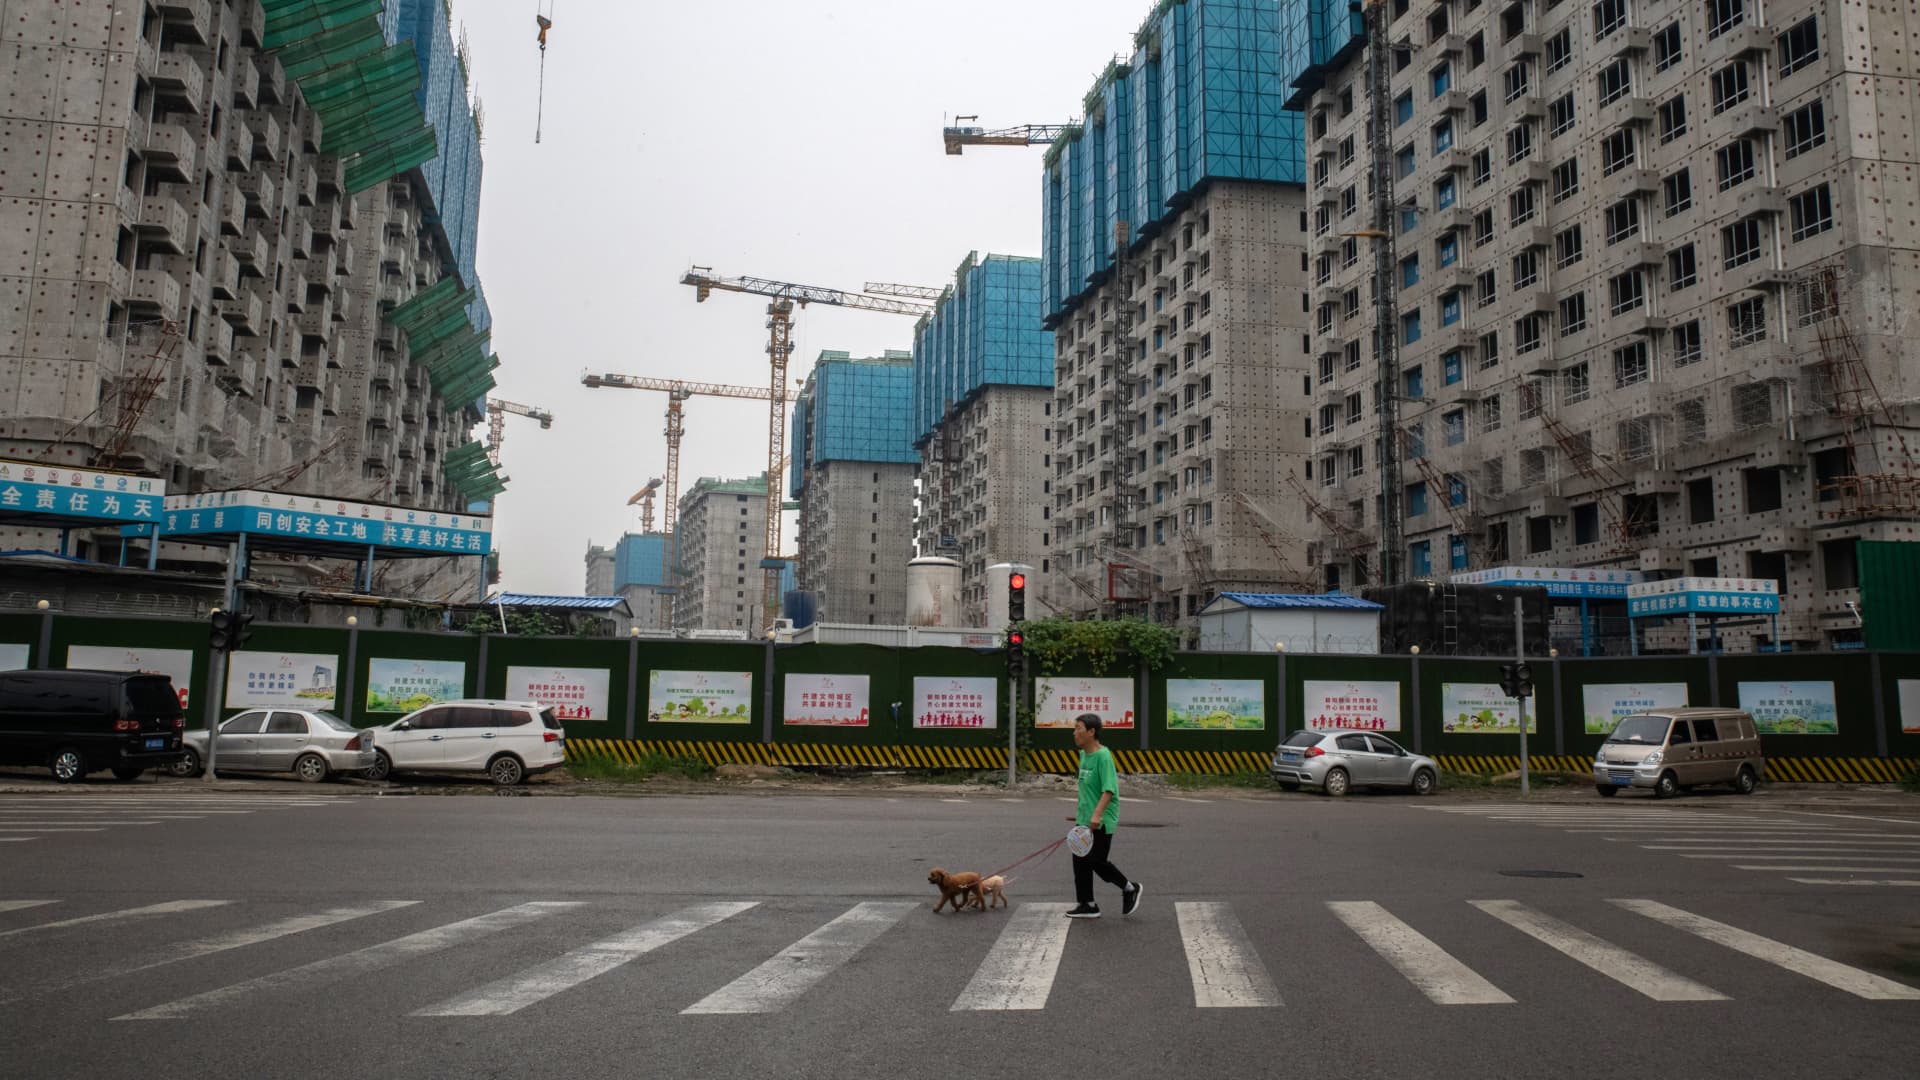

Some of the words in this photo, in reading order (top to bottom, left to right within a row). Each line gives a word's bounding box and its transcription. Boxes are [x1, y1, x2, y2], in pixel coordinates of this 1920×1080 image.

[1, 486, 152, 517] 全责任为天
[257, 511, 367, 539] 同创安全工地
[384, 525, 482, 550] 共享美好生活
[1697, 595, 1773, 609] 违章的事不在小
